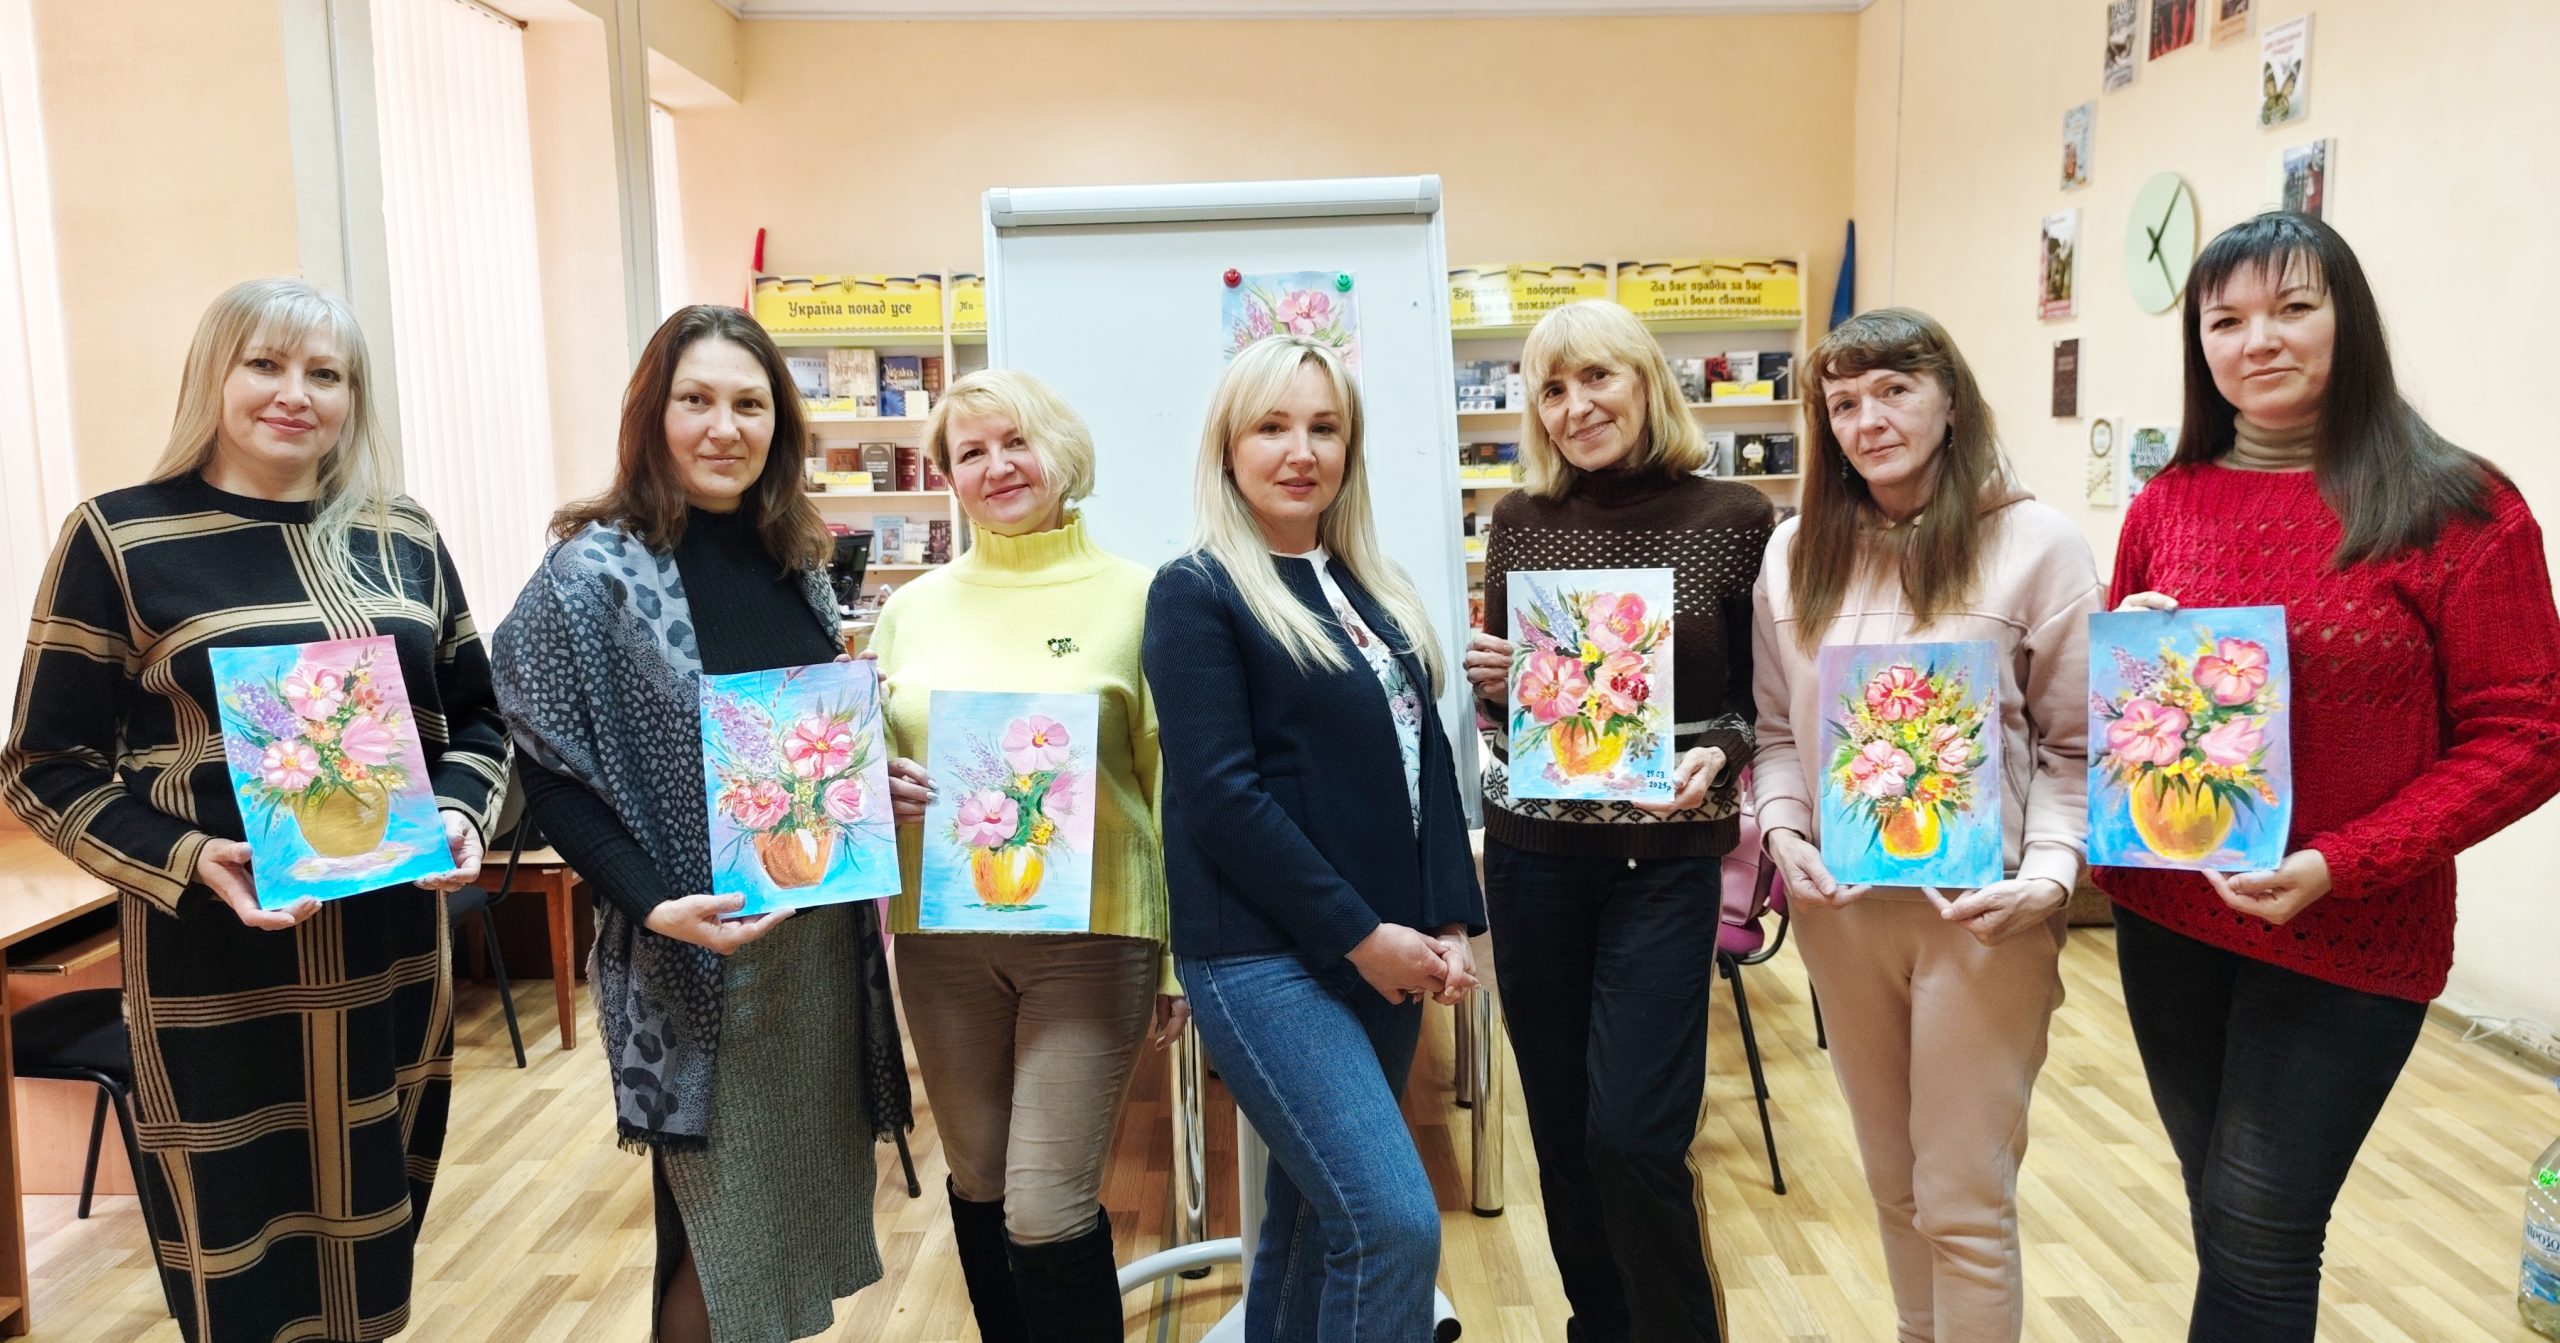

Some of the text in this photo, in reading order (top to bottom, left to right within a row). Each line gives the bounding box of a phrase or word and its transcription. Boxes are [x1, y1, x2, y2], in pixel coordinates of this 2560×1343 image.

[1650, 279, 1763, 294] За вас правда за вас
[958, 301, 974, 312] Ми
[1653, 296, 1679, 307] сила
[1690, 294, 1715, 306] воля
[788, 300, 912, 318] Україна понад усе
